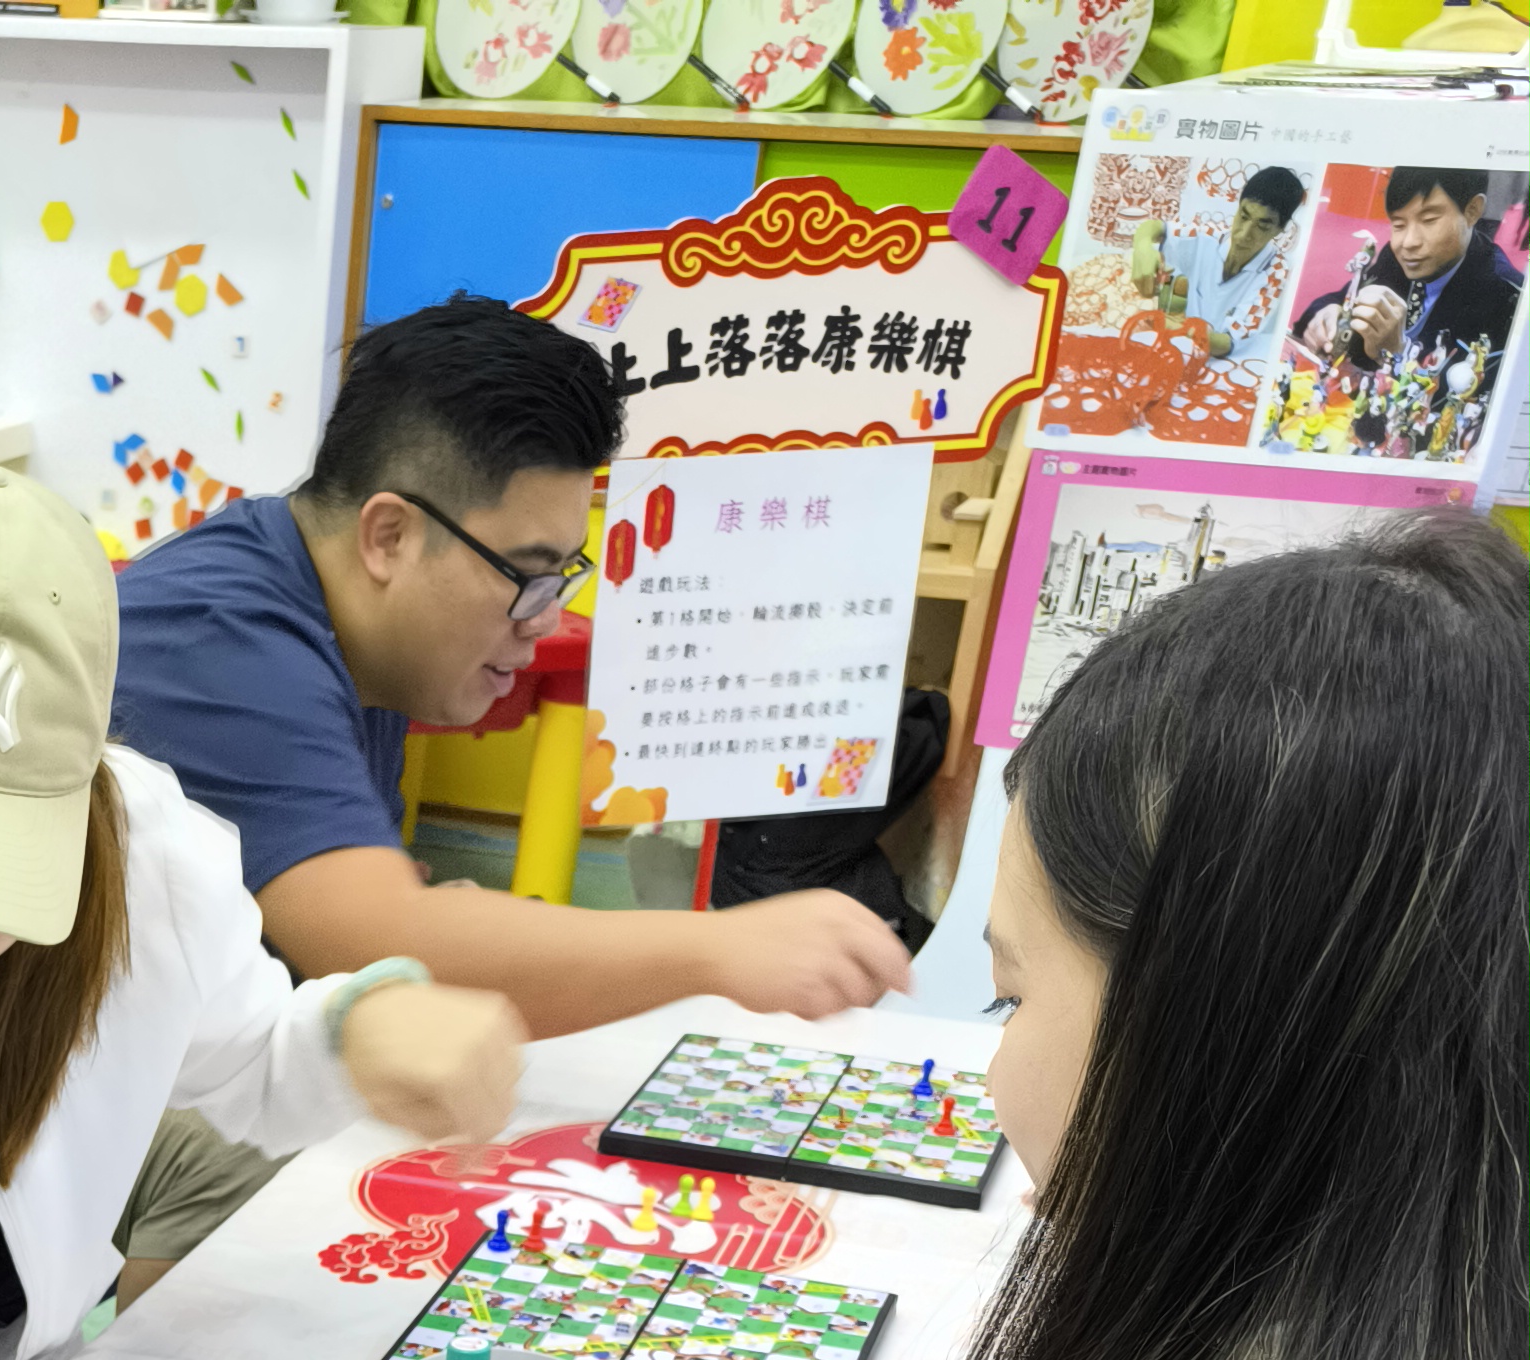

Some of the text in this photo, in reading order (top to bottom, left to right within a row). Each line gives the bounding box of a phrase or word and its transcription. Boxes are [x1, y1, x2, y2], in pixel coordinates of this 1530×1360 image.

[1175, 118, 1264, 142] 實物圖片
[976, 186, 1038, 253] 11
[609, 304, 973, 399] 上上落落康樂棋
[715, 495, 832, 534] 康樂棋
